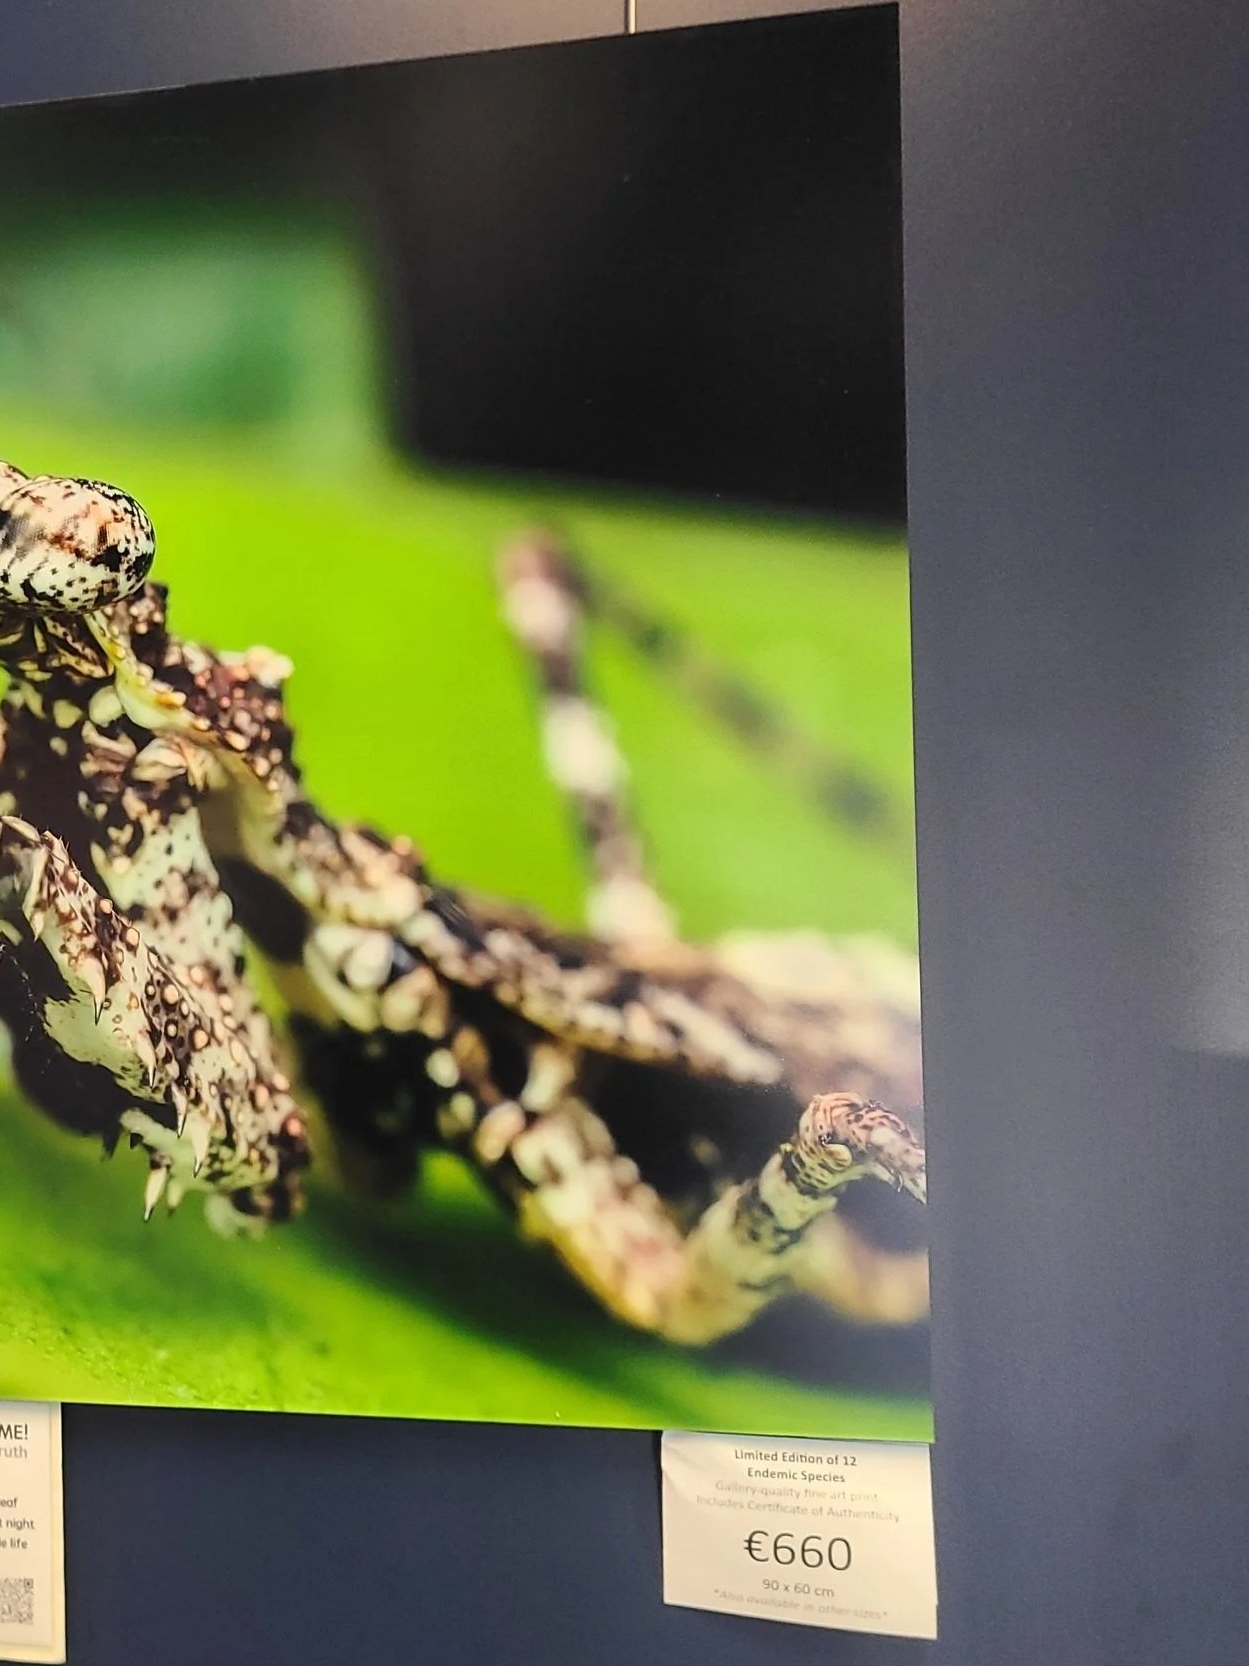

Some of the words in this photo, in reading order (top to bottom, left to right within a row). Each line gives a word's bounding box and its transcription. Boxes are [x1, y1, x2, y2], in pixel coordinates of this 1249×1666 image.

[734, 1449, 778, 1462] Limited
[782, 1451, 823, 1465] Edition
[826, 1454, 839, 1466] of
[843, 1455, 857, 1467] 12
[747, 1467, 798, 1481] Endemic
[801, 1470, 846, 1484] Species
[715, 1480, 801, 1499] Gallery-quality
[804, 1487, 827, 1499] fine
[697, 1495, 744, 1510] Includes
[747, 1499, 809, 1515] Certificate
[811, 1505, 824, 1516] of
[826, 1506, 900, 1523] Authenticity
[6, 1517, 35, 1531] night
[10, 1537, 28, 1550] life
[743, 1530, 852, 1571] €660
[762, 1578, 779, 1591] 90
[783, 1583, 791, 1593] x
[794, 1582, 811, 1595] 60
[814, 1586, 835, 1598] cm
